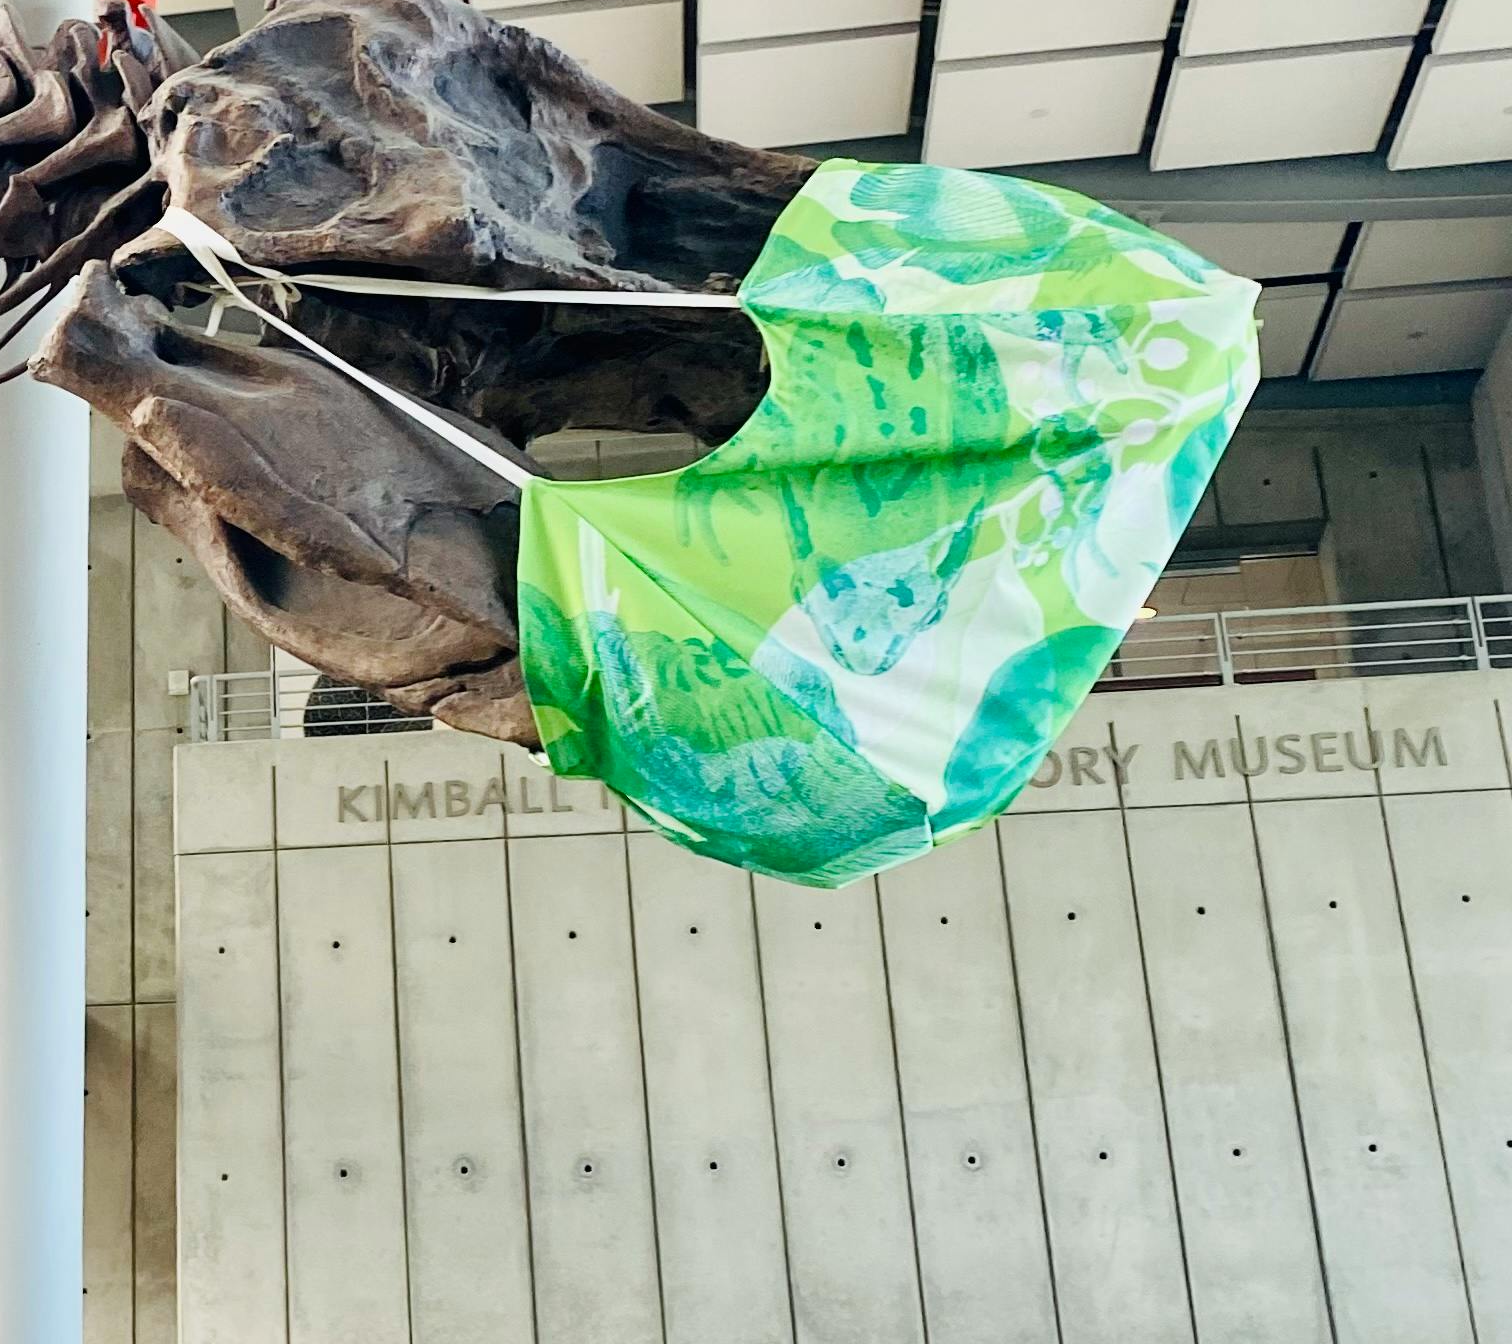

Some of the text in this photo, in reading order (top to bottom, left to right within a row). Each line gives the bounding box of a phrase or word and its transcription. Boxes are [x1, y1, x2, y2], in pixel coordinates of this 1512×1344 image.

[337, 773, 574, 824] KIMBALL
[1026, 743, 1142, 790] ORY
[1172, 724, 1450, 782] MUSEUM
